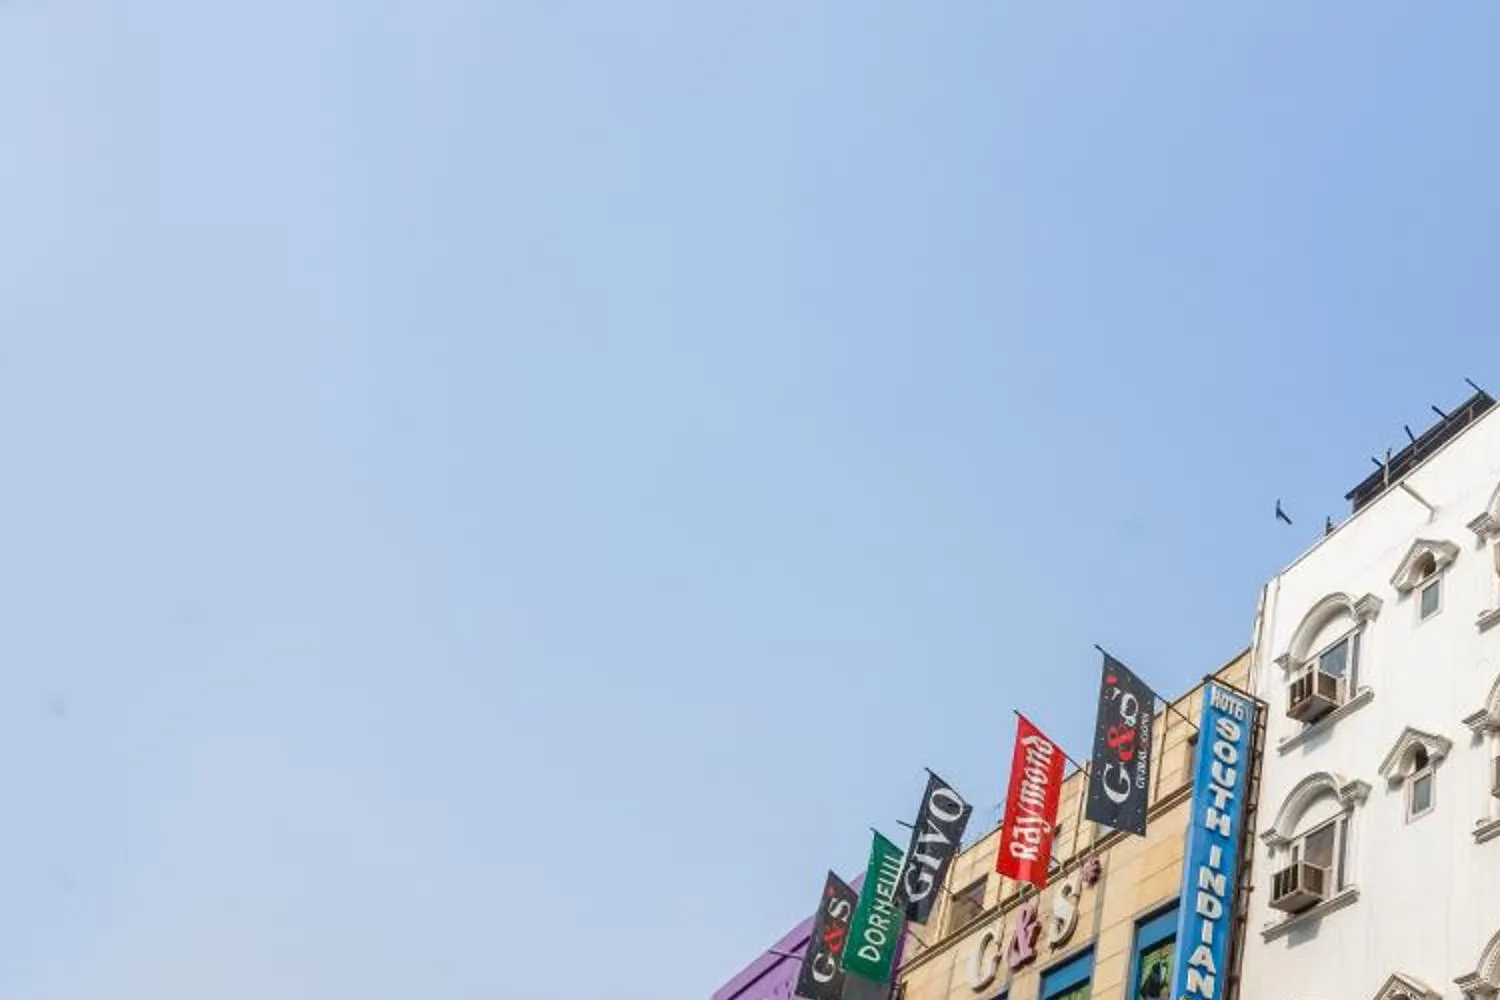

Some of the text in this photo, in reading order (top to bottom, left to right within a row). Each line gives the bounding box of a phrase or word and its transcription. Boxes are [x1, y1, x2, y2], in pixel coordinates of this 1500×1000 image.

[1009, 735, 1054, 861] Raymond
[1205, 717, 1241, 837] SOUTH
[1186, 844, 1227, 1000] INDIAN
